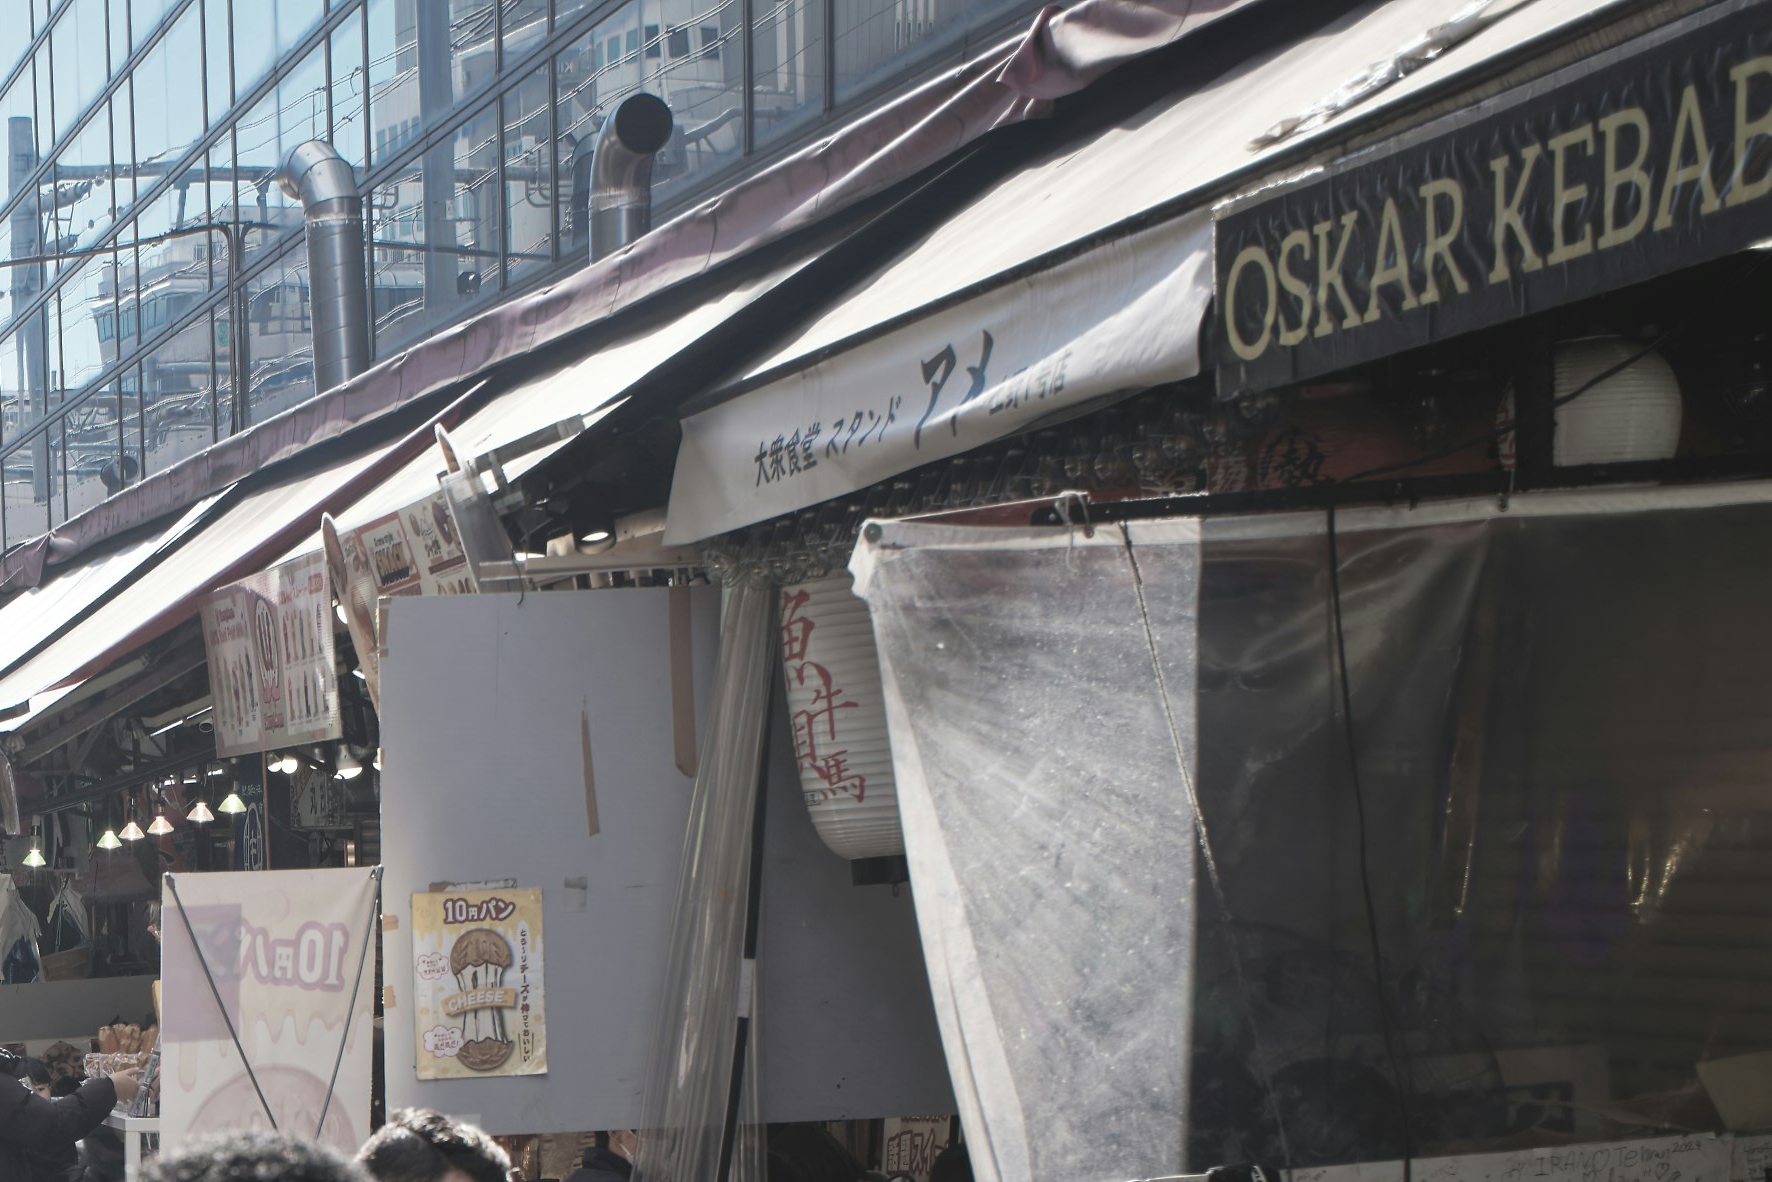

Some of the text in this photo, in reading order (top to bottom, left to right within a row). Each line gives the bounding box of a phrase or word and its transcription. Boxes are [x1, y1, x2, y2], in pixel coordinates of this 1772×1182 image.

[1225, 177, 1470, 362] OSKAR
[753, 422, 821, 487] 大衆食堂
[825, 396, 901, 456] スタンド
[913, 330, 994, 450] アメ
[443, 898, 516, 924] 10円パン
[448, 989, 505, 1012] CHEESE
